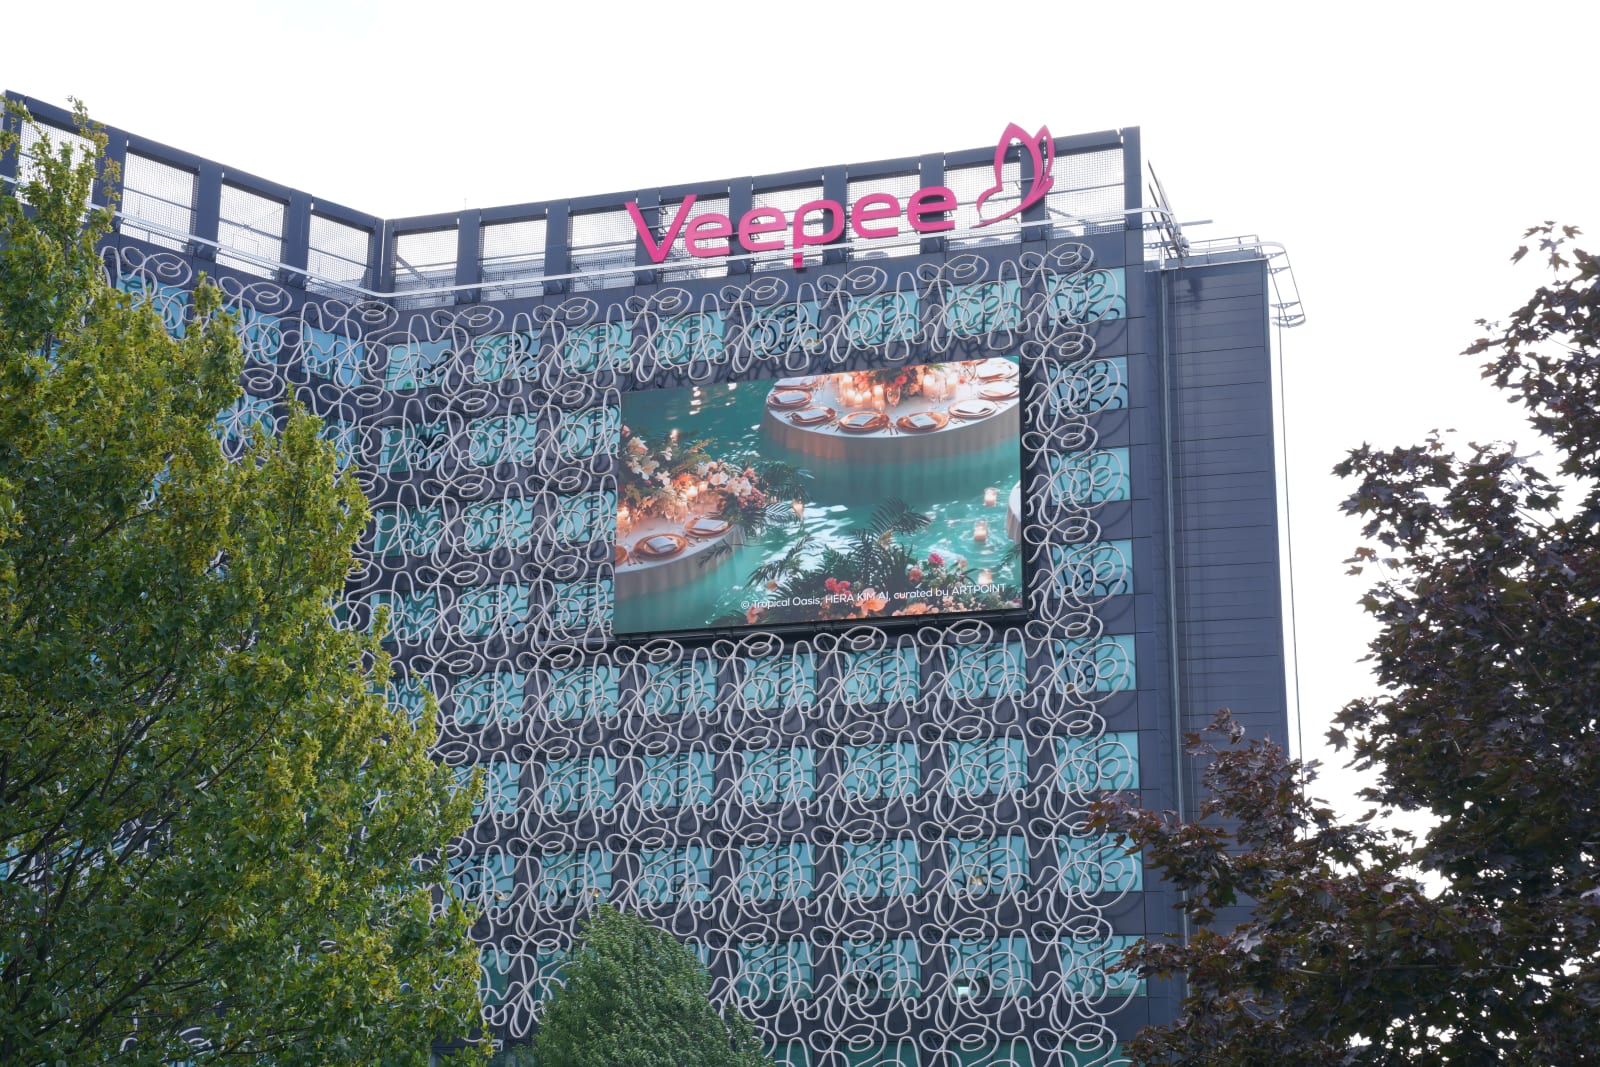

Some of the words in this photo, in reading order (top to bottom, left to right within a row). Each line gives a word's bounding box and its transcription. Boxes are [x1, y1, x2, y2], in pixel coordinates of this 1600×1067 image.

[625, 186, 957, 268] Veepee
[753, 598, 790, 609] Tropical
[792, 596, 823, 606] Oasis,
[825, 594, 854, 604] HERA
[857, 592, 876, 602] KIM
[893, 587, 933, 599] curated
[935, 587, 949, 598] by
[951, 583, 1007, 595] ARTPOINT
